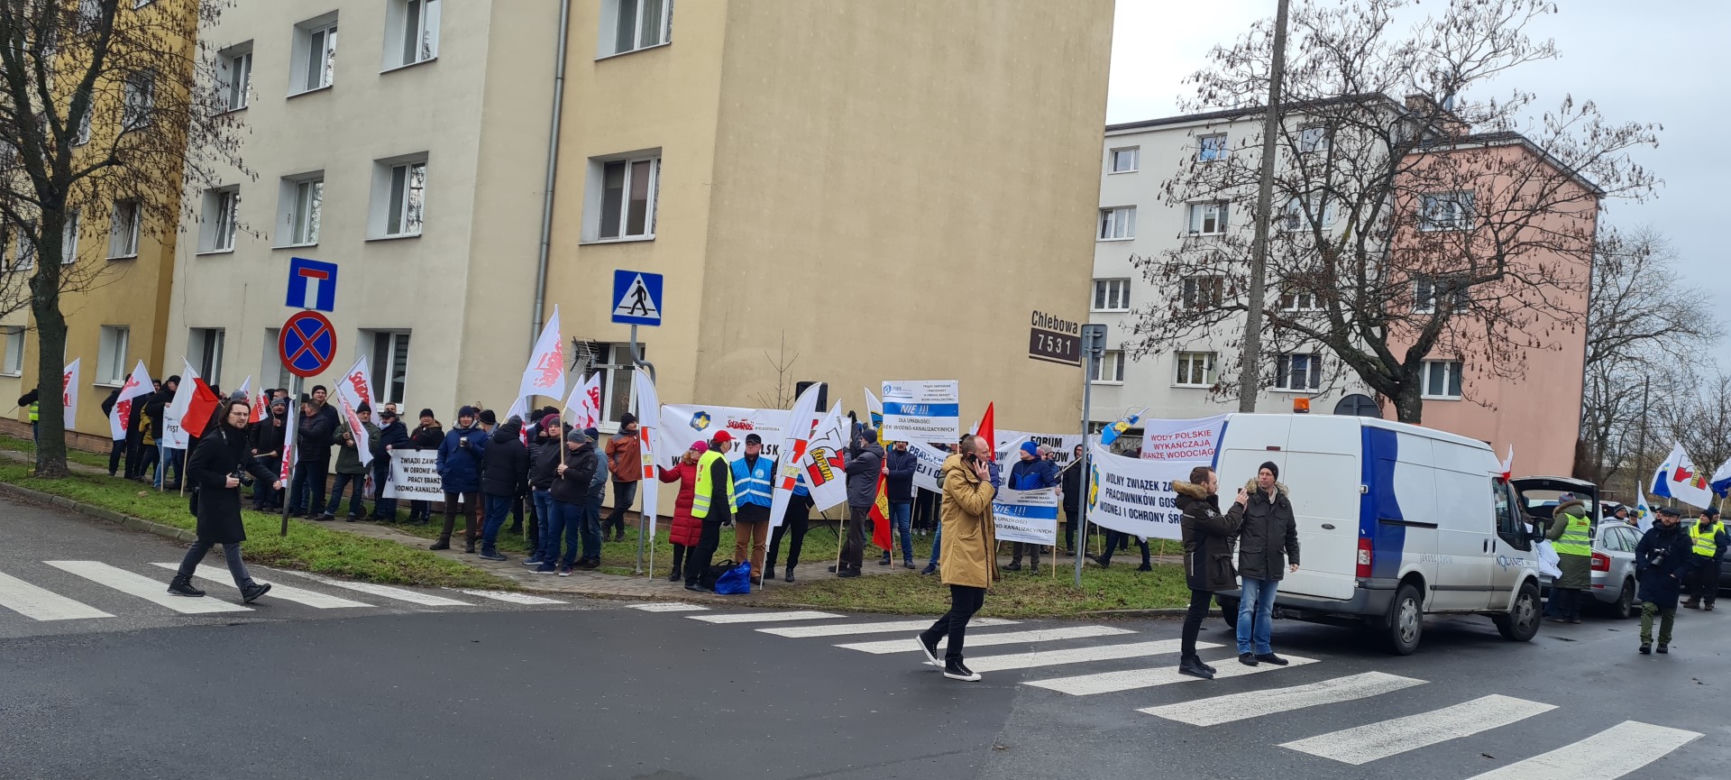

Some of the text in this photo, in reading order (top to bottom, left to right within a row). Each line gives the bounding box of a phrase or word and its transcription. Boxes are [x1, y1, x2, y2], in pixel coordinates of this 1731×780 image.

[1031, 310, 1078, 334] Chlebowa
[901, 404, 917, 414] NIE
[1030, 436, 1063, 448] FORUM
[1151, 429, 1212, 441] WODY POLSKIE
[1105, 472, 1125, 486] WOLNY
[1126, 477, 1159, 492] ZWIĄZEK
[1105, 487, 1156, 507] PRACOWNIKÓW
[1100, 501, 1122, 516] WODNEJ
[1129, 508, 1164, 523] OCHRONY
